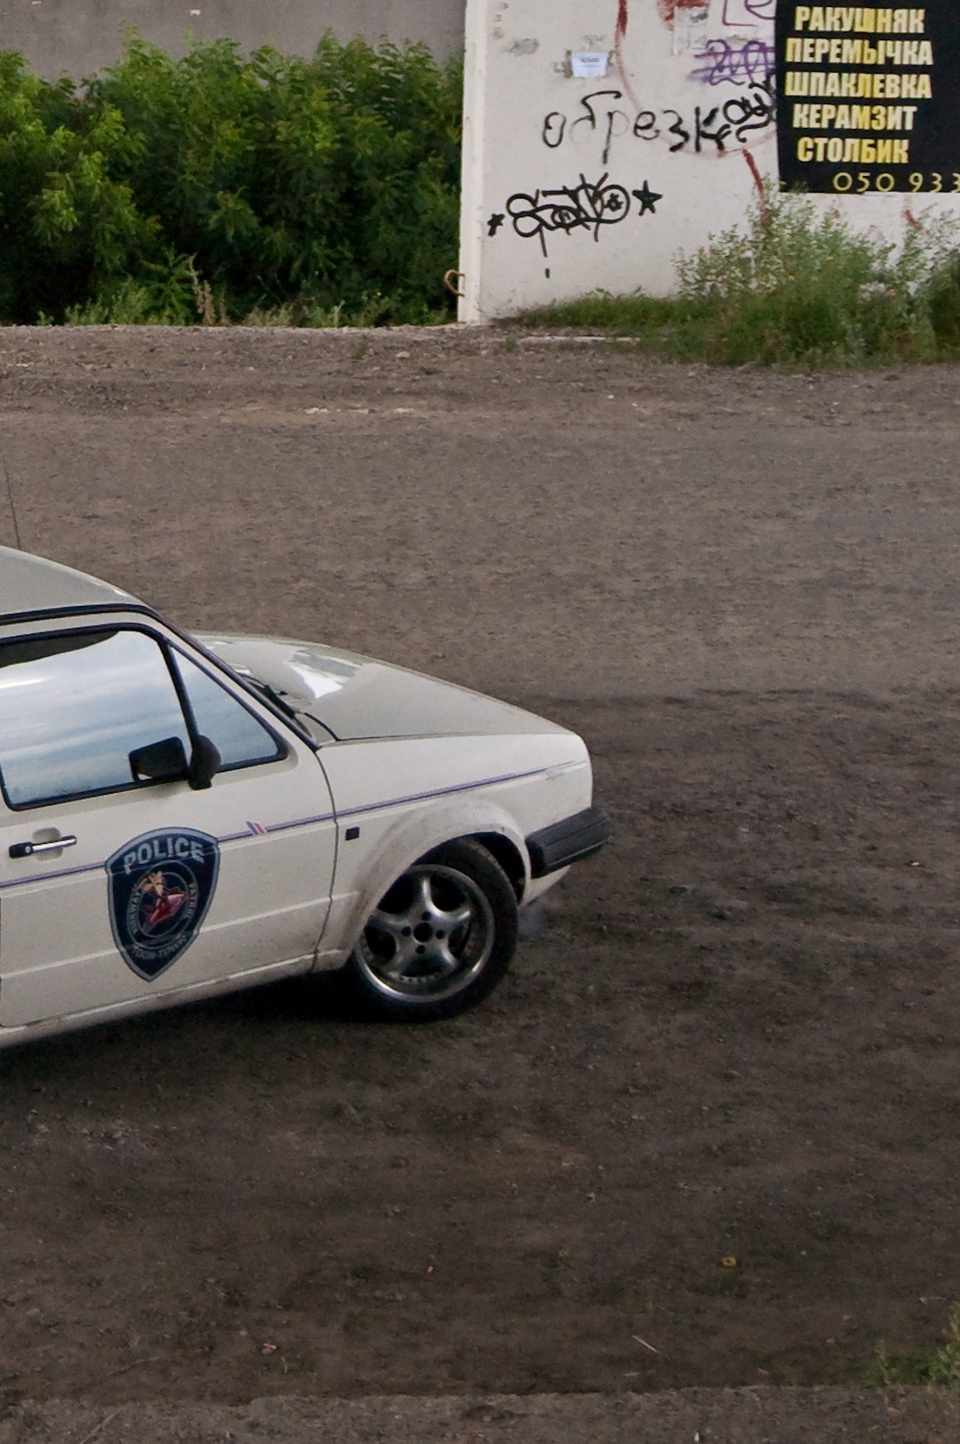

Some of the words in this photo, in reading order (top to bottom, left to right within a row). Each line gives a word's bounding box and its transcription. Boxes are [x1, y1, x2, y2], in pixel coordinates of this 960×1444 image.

[794, 6, 926, 34] РАКУШНЯК
[785, 37, 934, 65] ПЕРЕМЫЧКА
[785, 71, 933, 99] ШПАКЛЕВКА
[793, 103, 918, 130] КЕРАМЗИТ
[797, 136, 909, 164] СТОЛБИК
[832, 172, 895, 193] 050
[123, 837, 205, 875] POLICE
